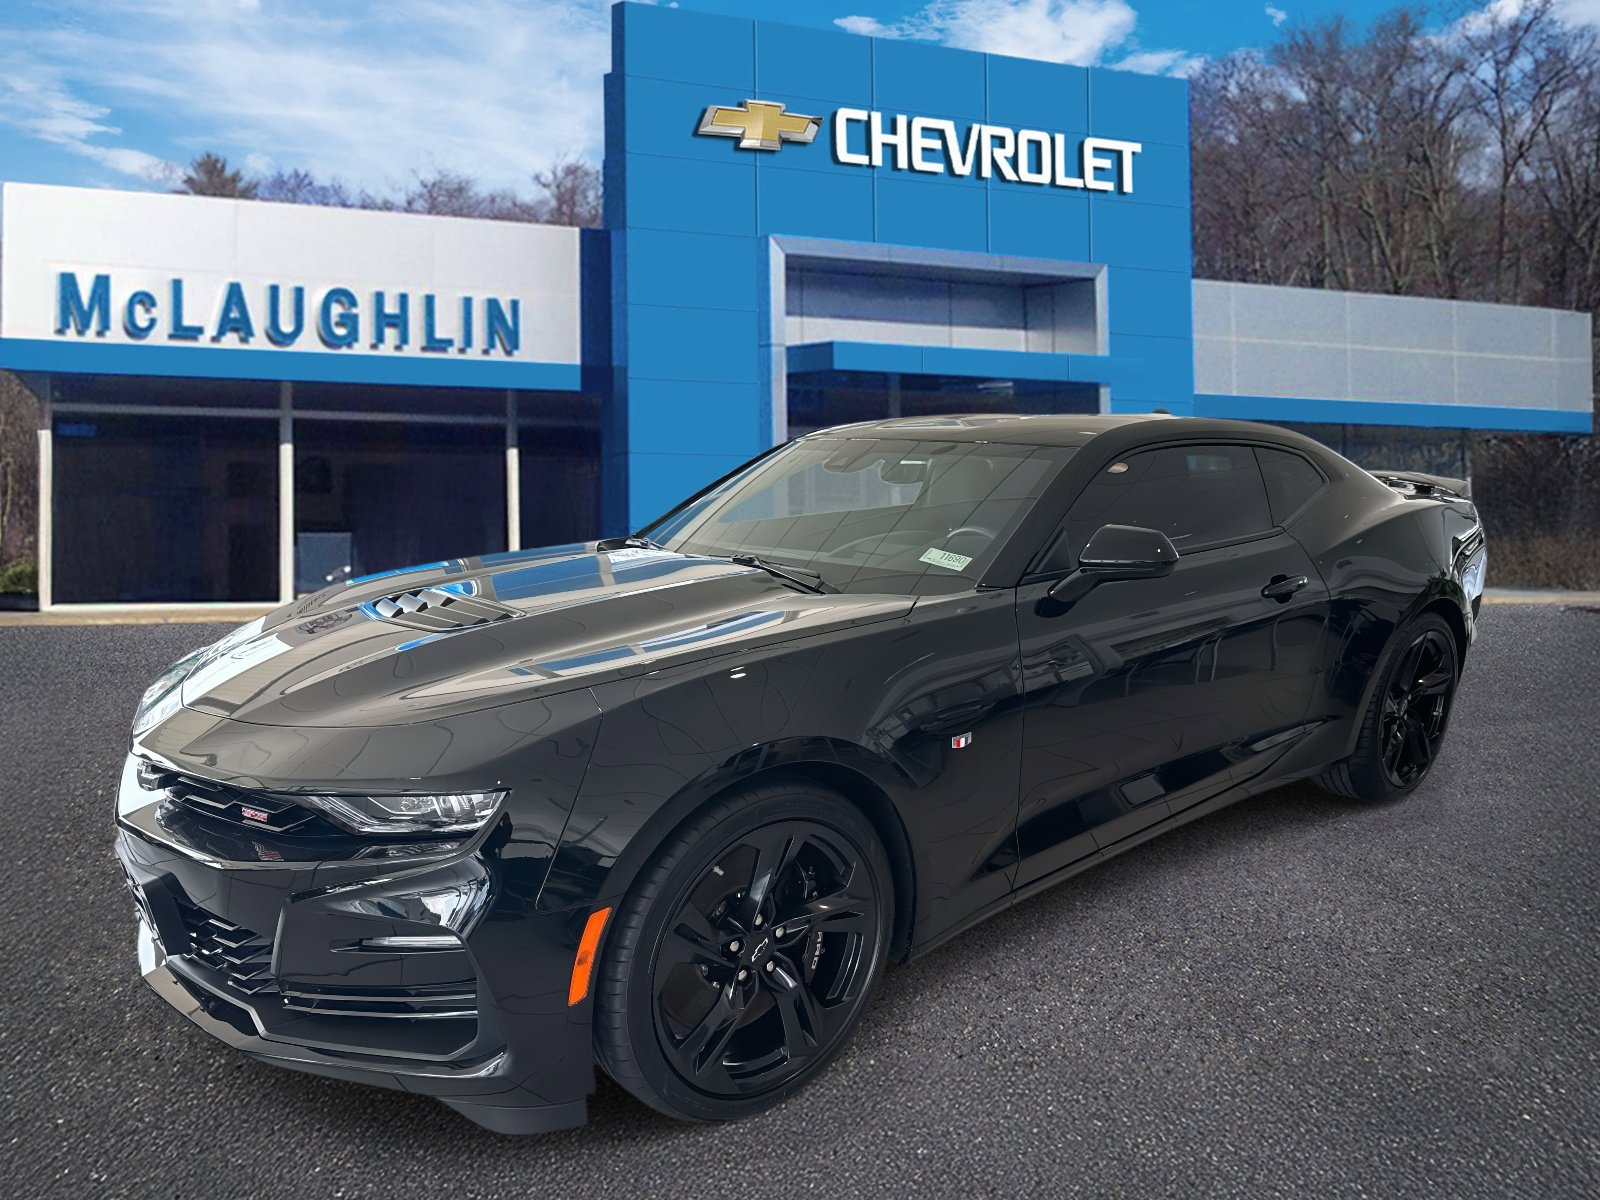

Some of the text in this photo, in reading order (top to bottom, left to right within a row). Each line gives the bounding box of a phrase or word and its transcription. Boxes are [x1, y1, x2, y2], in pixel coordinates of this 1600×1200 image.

[836, 107, 1142, 194] CHEVROLET
[55, 272, 520, 357] McLAUGHLIN
[941, 553, 966, 564] 11690
